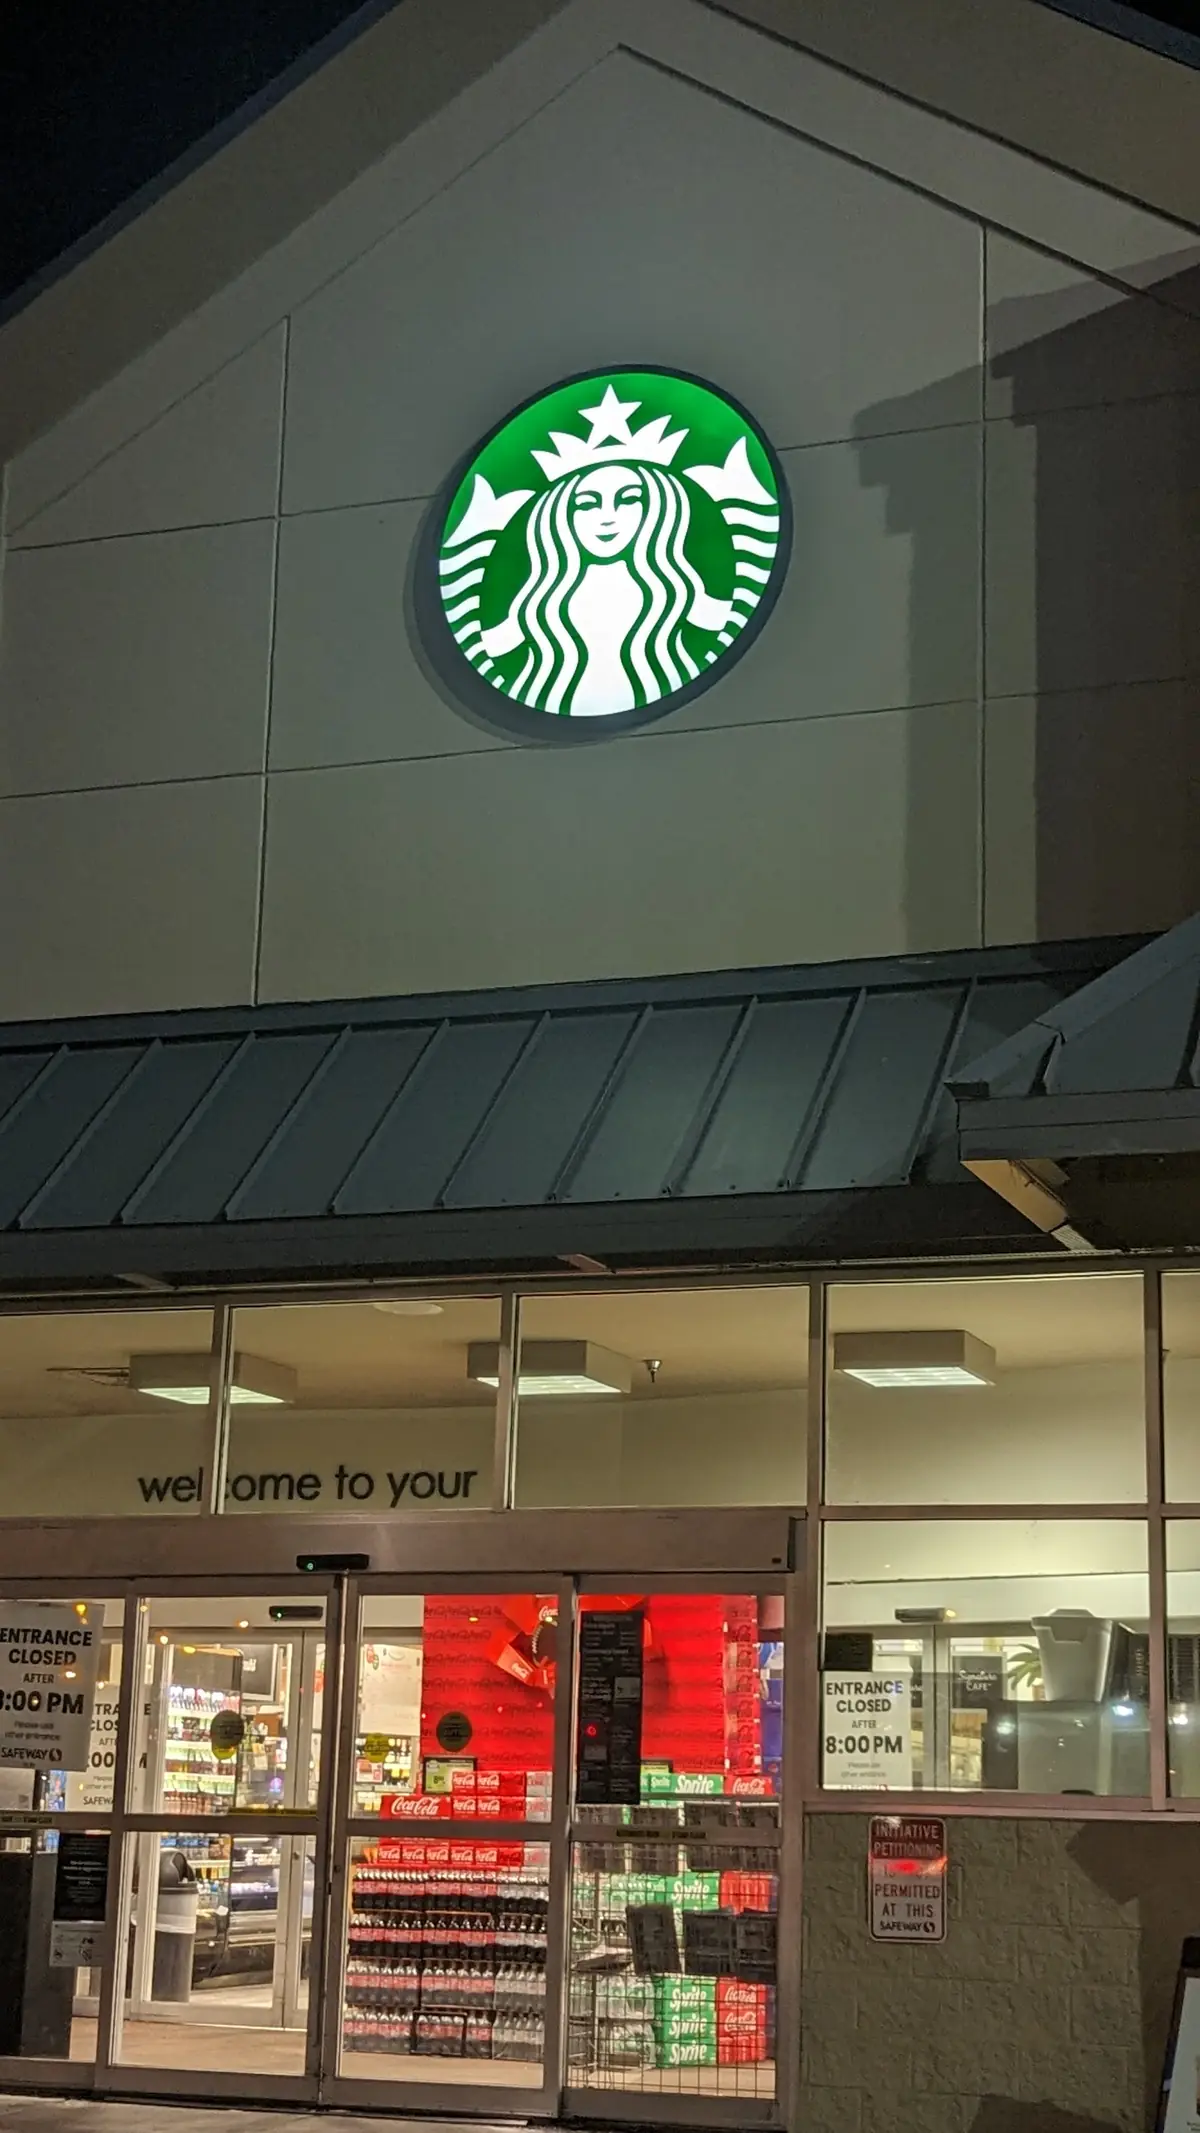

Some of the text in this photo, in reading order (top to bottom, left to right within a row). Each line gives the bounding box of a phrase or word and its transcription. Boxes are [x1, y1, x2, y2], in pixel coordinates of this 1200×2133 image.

[138, 1465, 478, 1509] welome to your
[0, 1627, 93, 1647] ENTRANCE
[8, 1649, 77, 1666] CLOSED
[23, 1673, 55, 1684] AFTER
[826, 1680, 903, 1695] ENTRANCE
[46, 1692, 85, 1715] PM
[836, 1699, 892, 1713] CLOSED
[851, 1720, 877, 1729] AFTER
[826, 1735, 903, 1754] 8:00 PM
[1, 1747, 48, 1760] SAFEWAY
[675, 1771, 714, 1794] Sprite
[391, 1796, 440, 1815] Coca-Cola
[876, 1824, 939, 1838] INITIATIVE
[874, 1841, 941, 1856] PETITIONING
[875, 1883, 940, 1898] PERMITTED
[882, 1903, 934, 1917] AT THIS
[880, 1921, 921, 1931] SAFEWAY
[670, 1986, 707, 2011] Sprite
[669, 2013, 708, 2039] Sprite
[669, 2040, 708, 2065] Sprite
